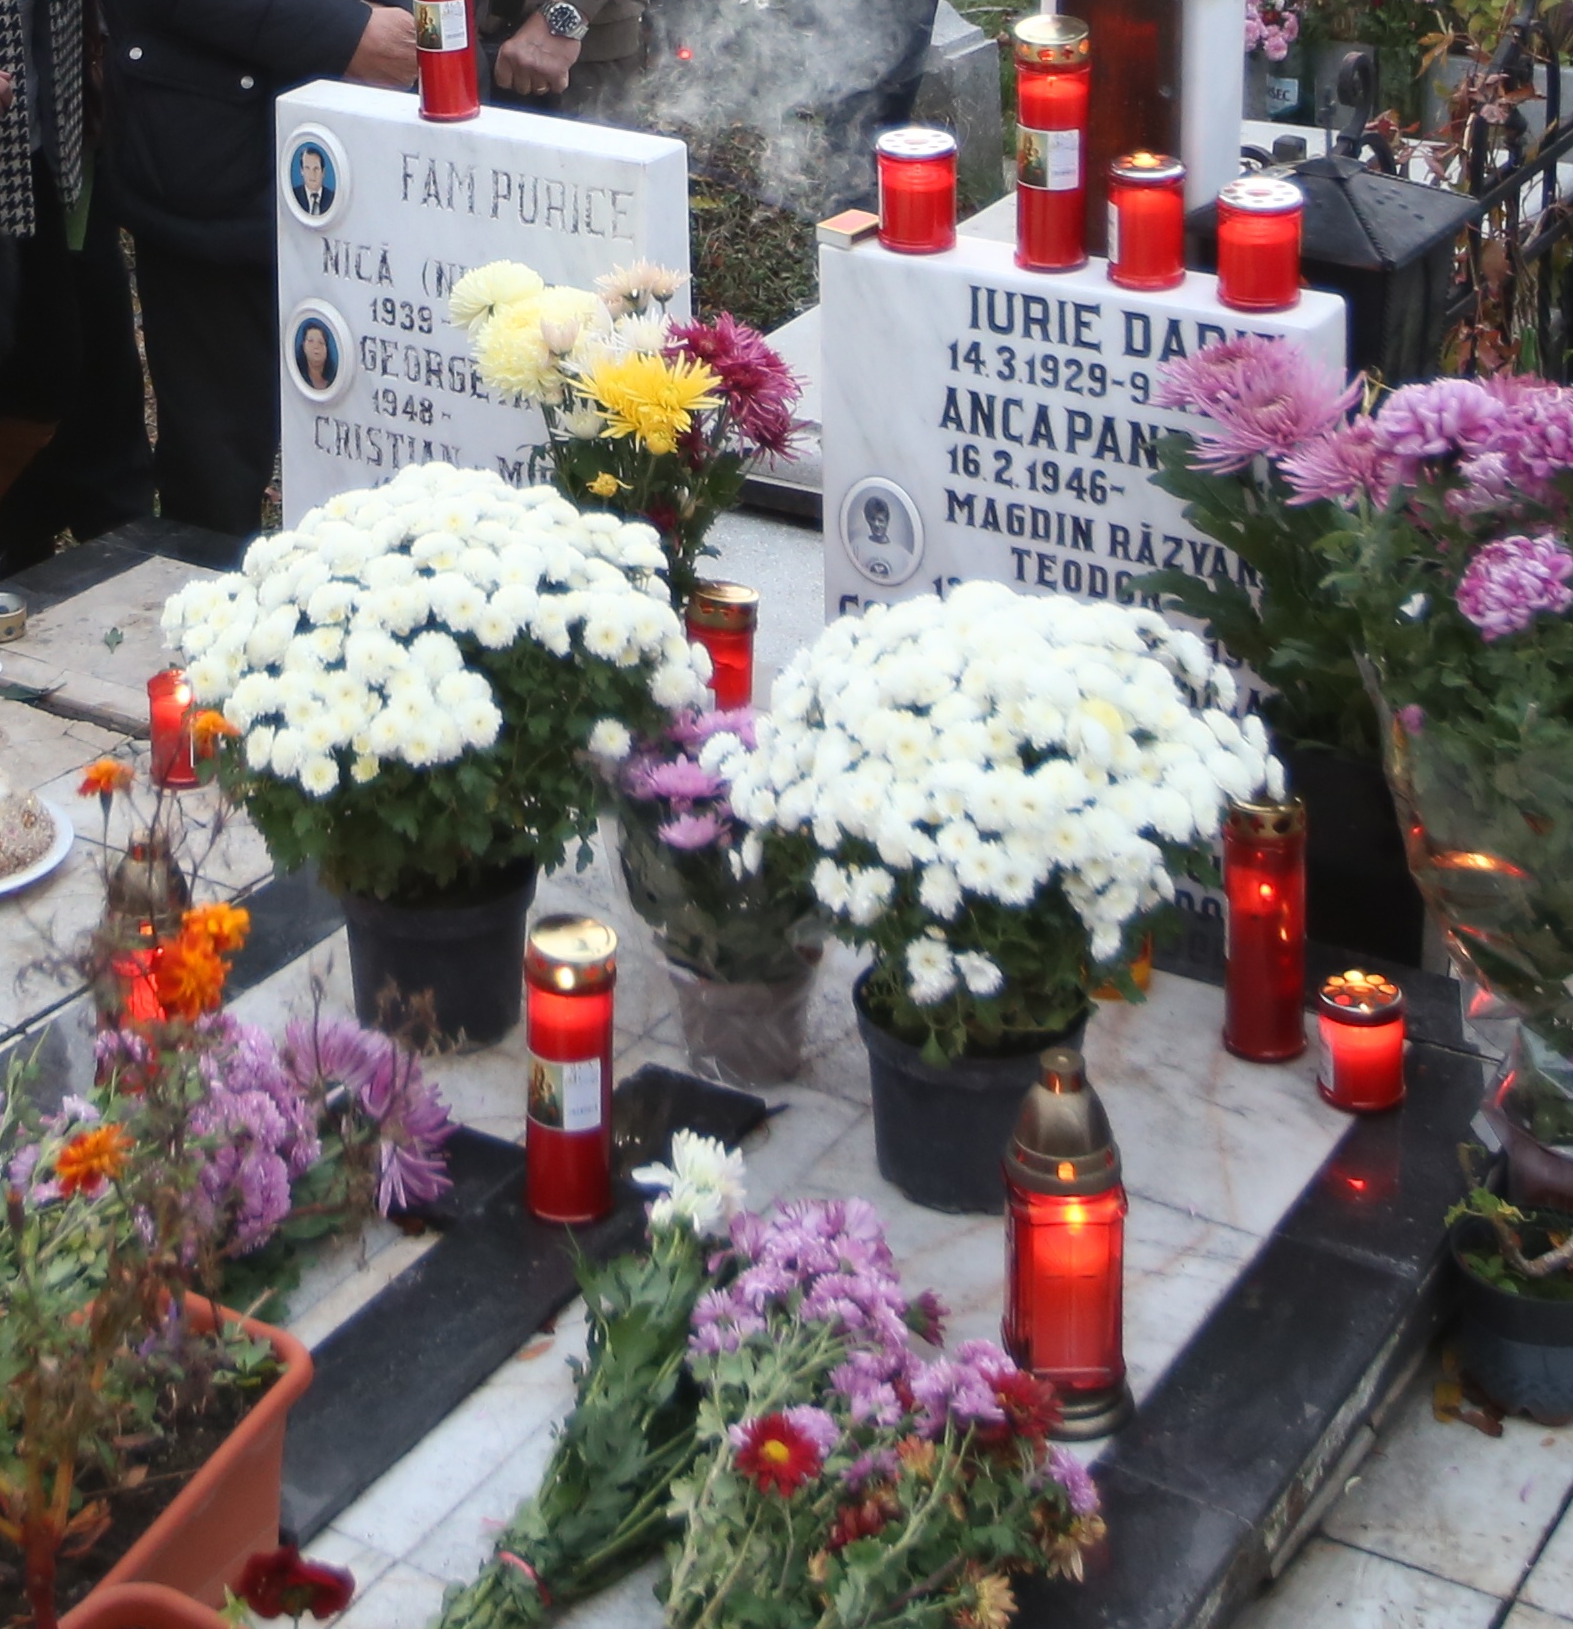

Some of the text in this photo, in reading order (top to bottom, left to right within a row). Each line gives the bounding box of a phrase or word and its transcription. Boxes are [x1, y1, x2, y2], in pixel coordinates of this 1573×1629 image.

[491, 169, 635, 244] PURICE
[968, 285, 1285, 362] IURIE DAR
[360, 335, 533, 411] GEORGE
[938, 386, 1059, 451] ANCA
[943, 488, 1095, 553] MAGDIN
